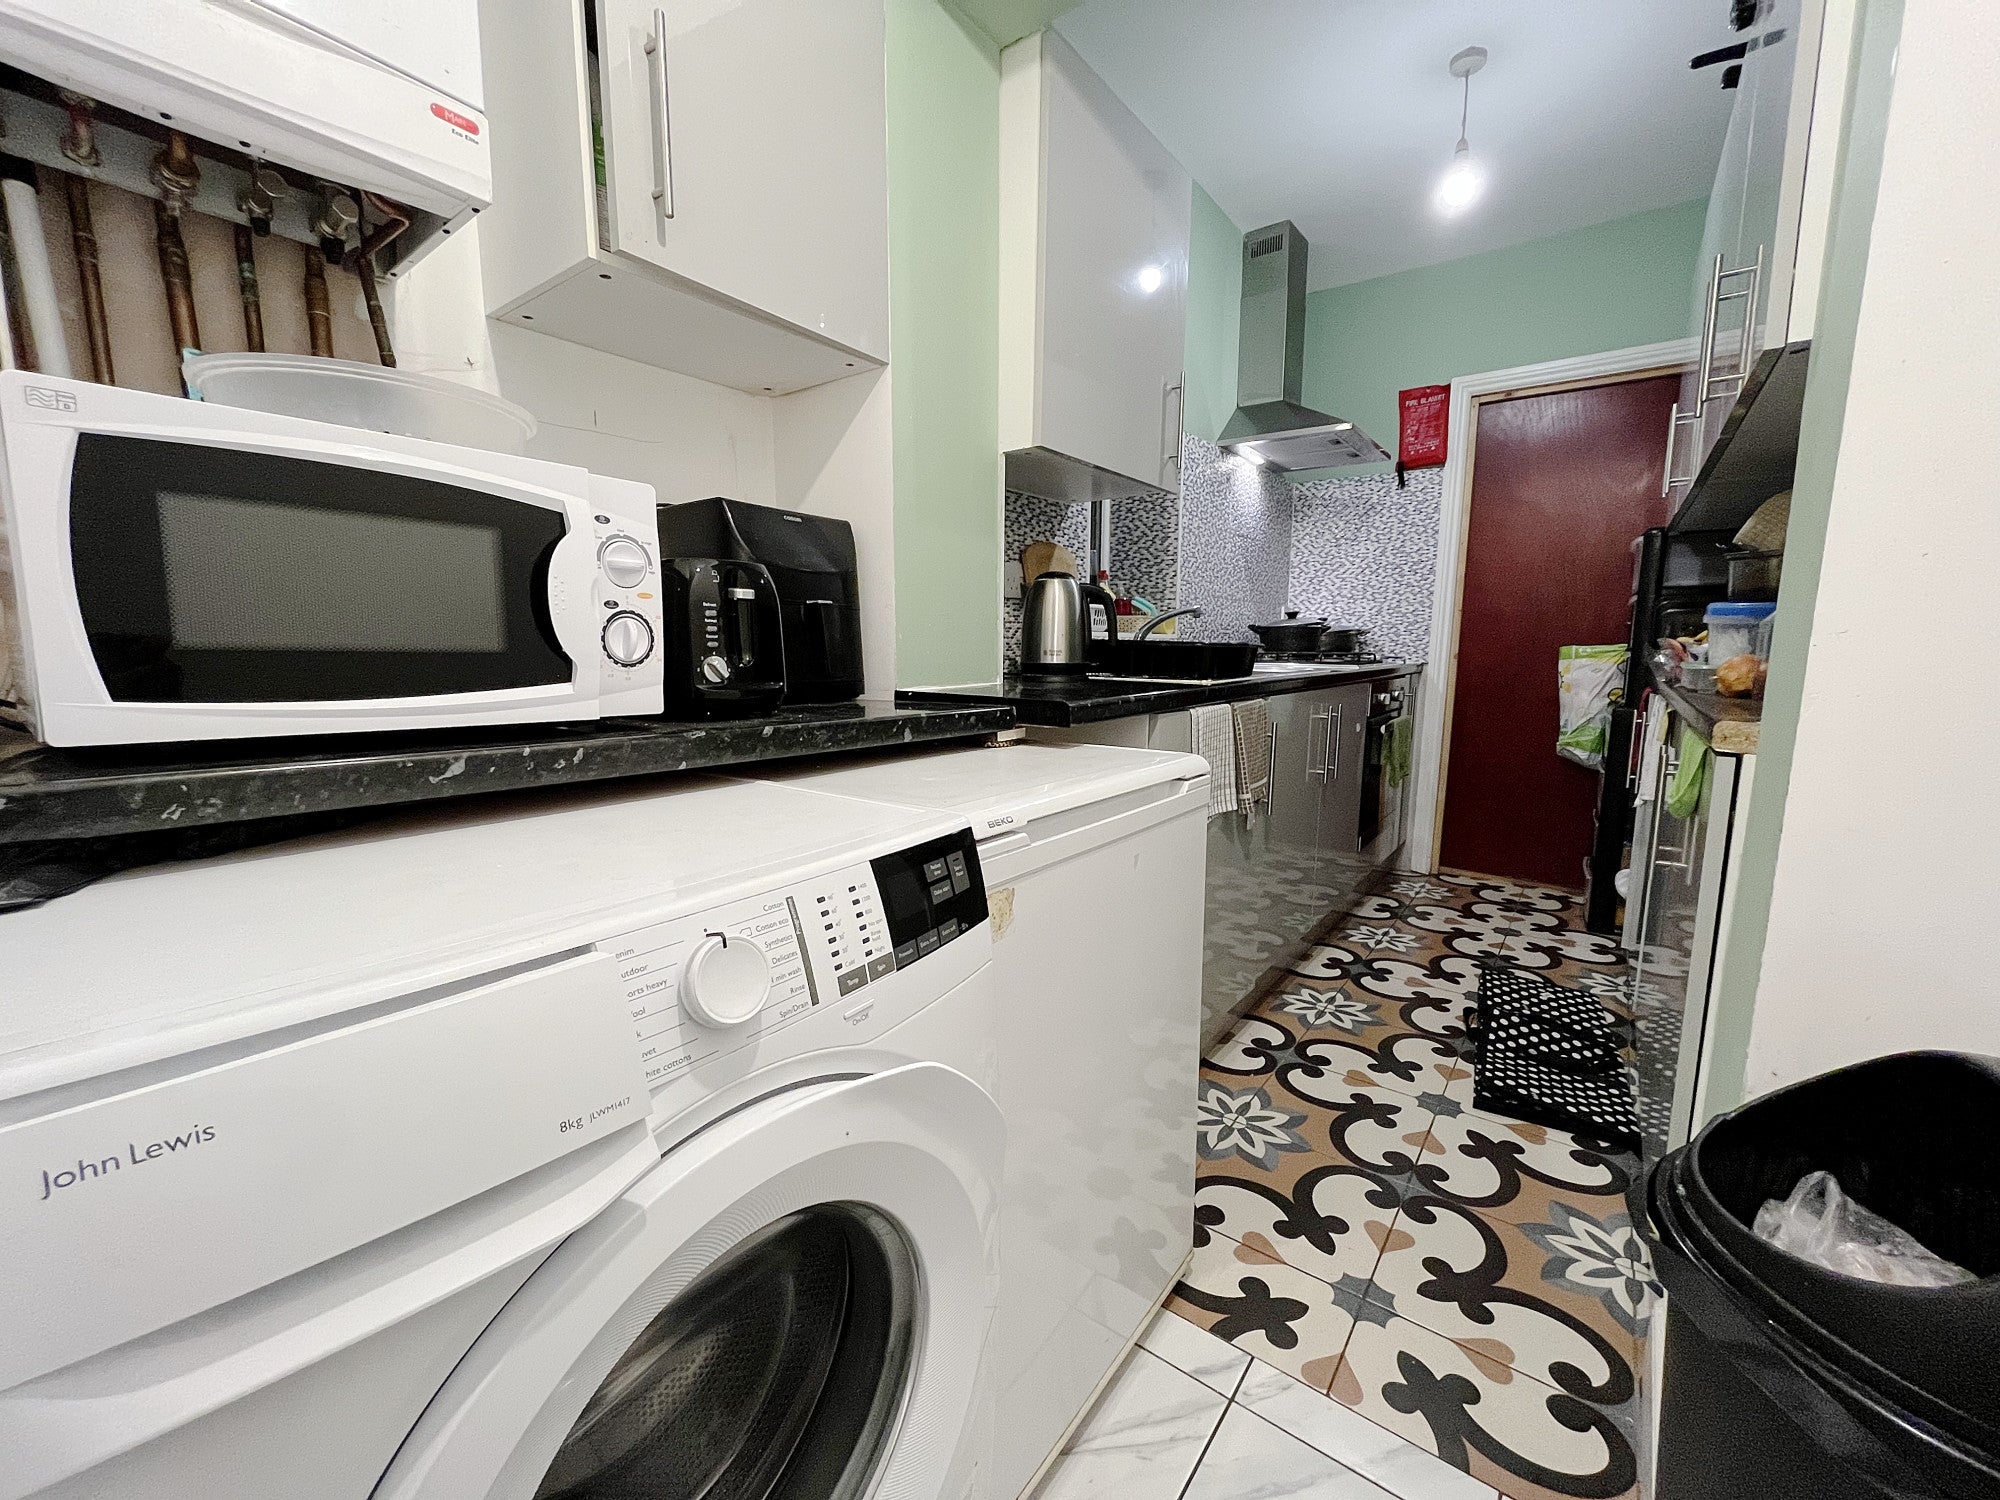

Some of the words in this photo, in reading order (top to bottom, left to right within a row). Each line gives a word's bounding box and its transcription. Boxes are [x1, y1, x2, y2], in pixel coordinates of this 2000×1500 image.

[1420, 394, 1445, 404] BLANKET
[987, 816, 1013, 829] BEKO
[762, 901, 785, 912] Cotton
[755, 920, 775, 933] Cotton
[764, 933, 793, 949] Synthetics
[771, 950, 798, 964] Delicates
[620, 964, 649, 979] utdoor
[646, 978, 668, 991] heavy
[789, 984, 806, 995] Rinse
[630, 1006, 646, 1019] ool
[779, 1001, 809, 1018] Spin/Drain
[662, 1053, 692, 1071] cottons
[559, 1117, 584, 1133] 8kg
[589, 1096, 631, 1123] JLWM1417
[40, 1155, 121, 1201] John
[129, 1124, 216, 1165] Lewis
